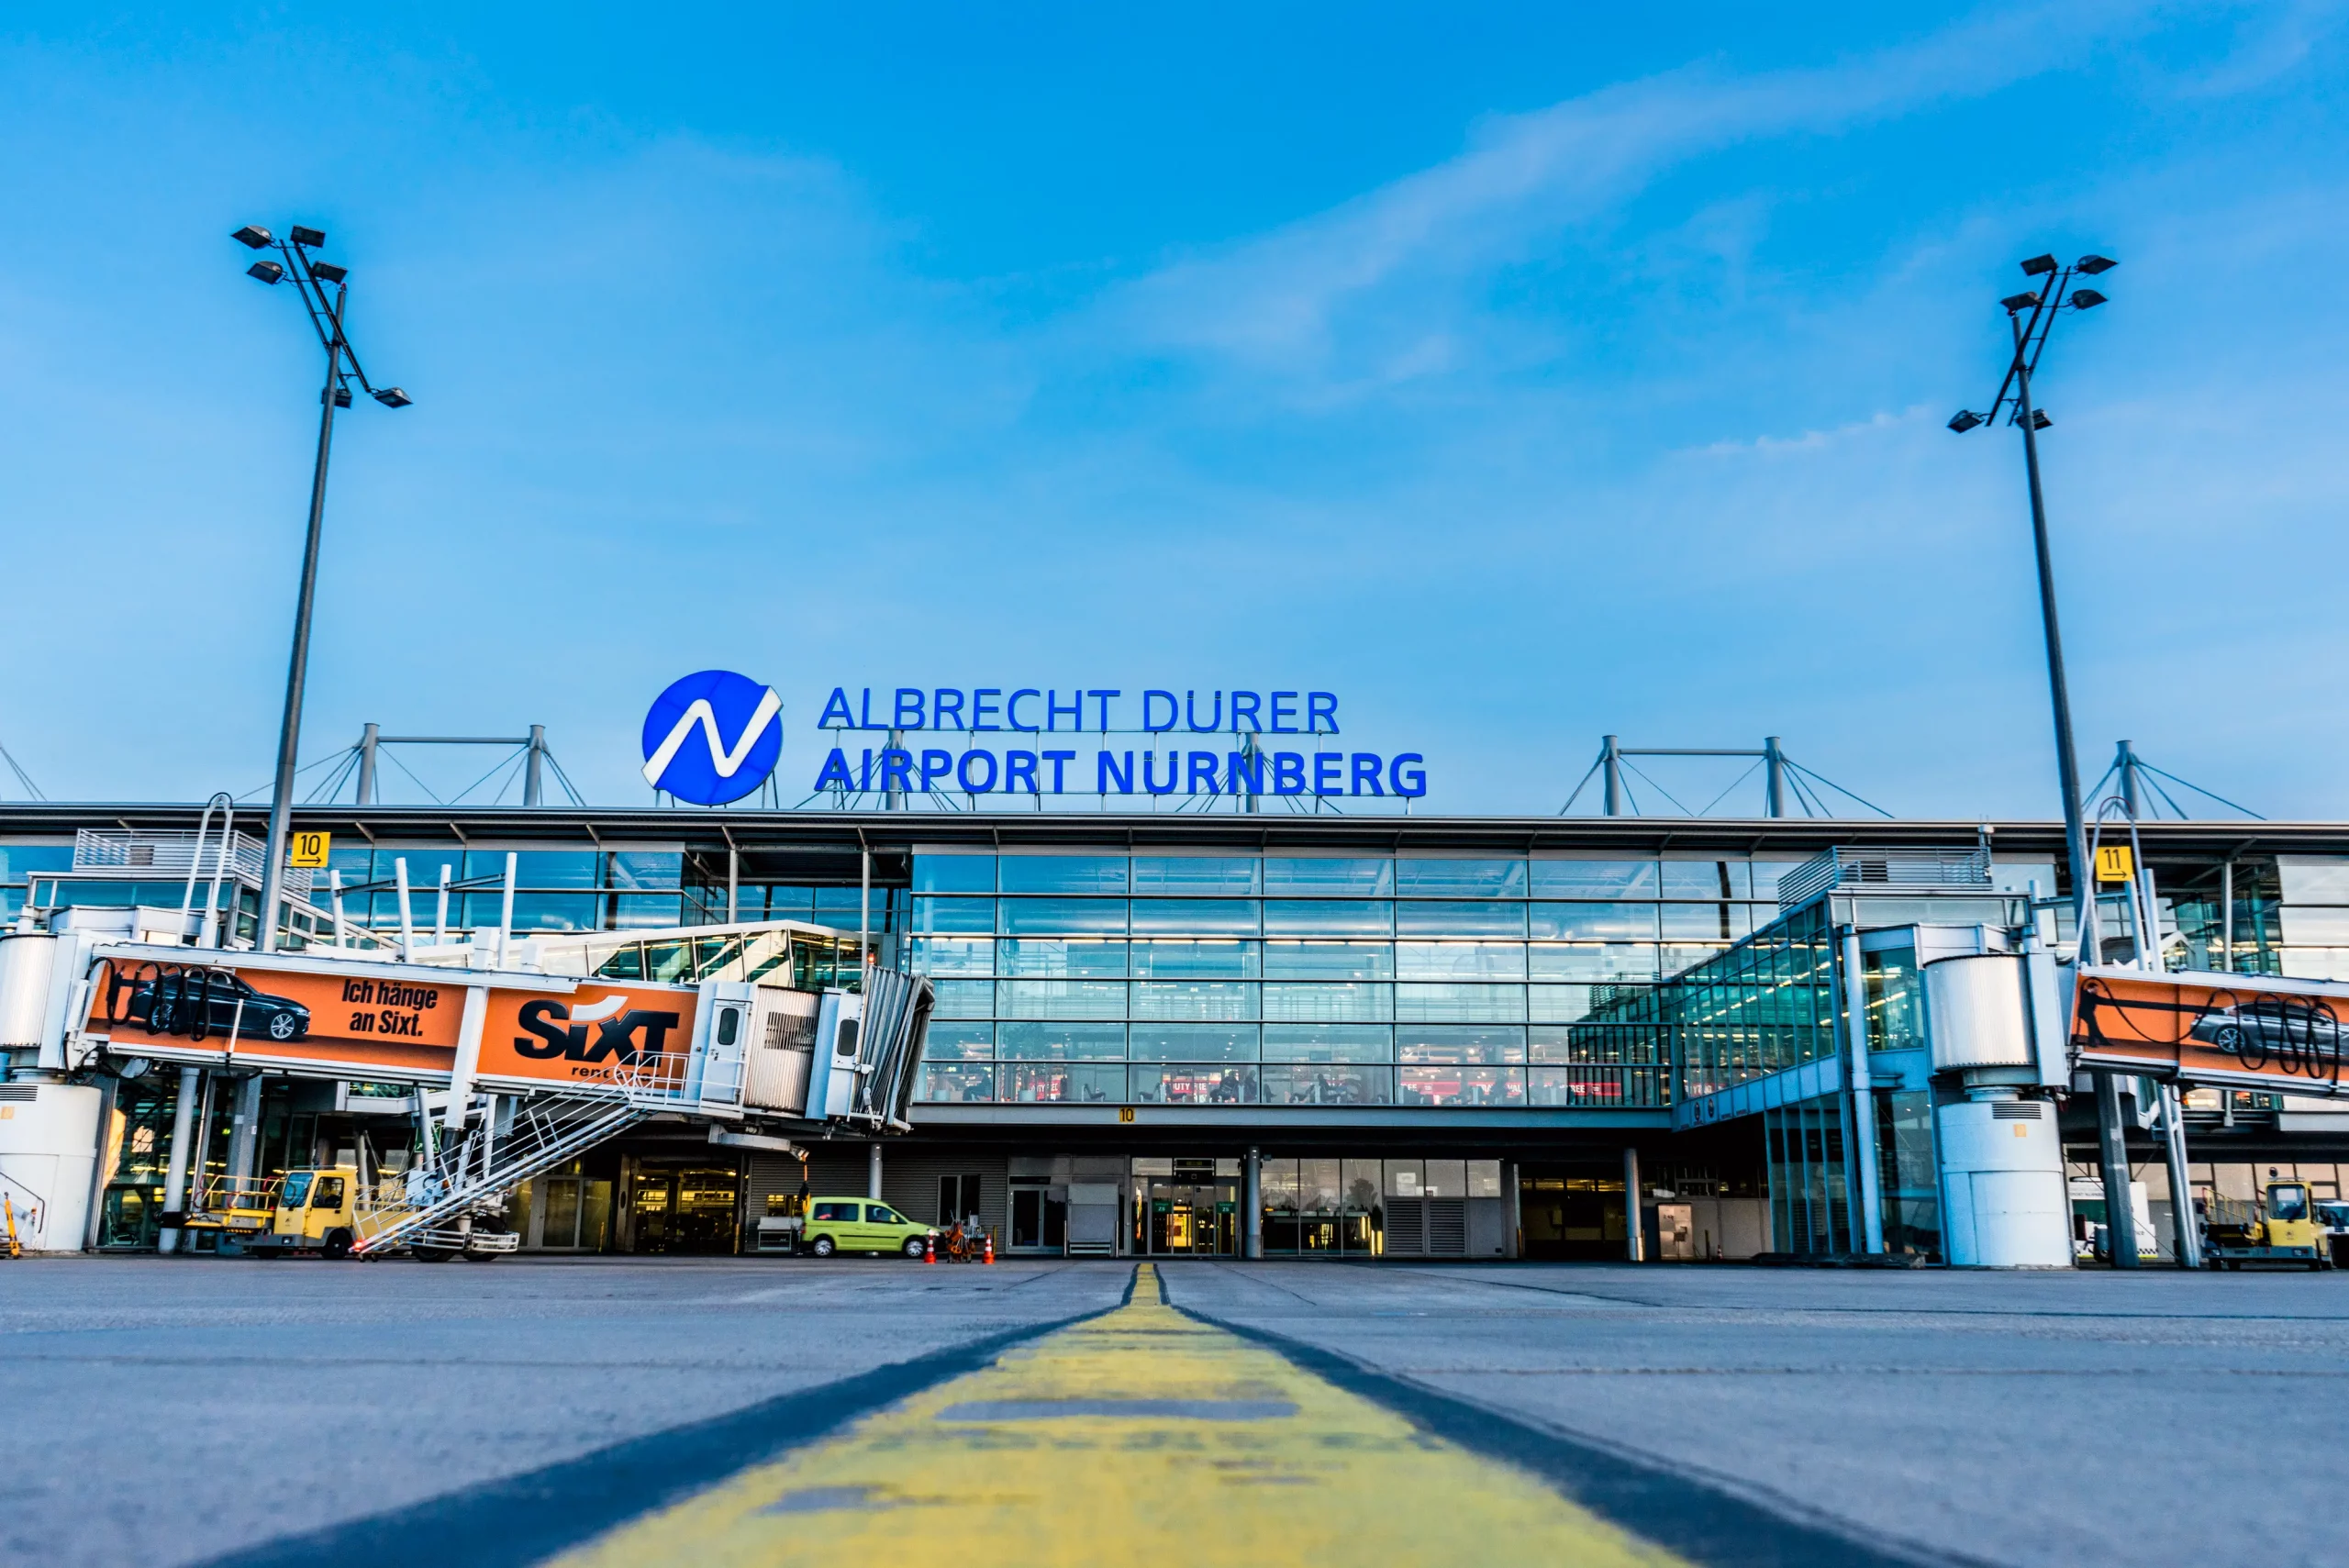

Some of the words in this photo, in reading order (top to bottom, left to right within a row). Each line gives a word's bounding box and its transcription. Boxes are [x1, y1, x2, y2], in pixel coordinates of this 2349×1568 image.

[818, 686, 1120, 732] ALBRECHT
[814, 748, 1076, 795] AIRPORT
[301, 834, 321, 856] 10
[2104, 848, 2121, 870] 11
[341, 978, 374, 1004] Ich
[376, 981, 439, 1011] hänge
[349, 1011, 375, 1032] an
[378, 1009, 424, 1037] Sixt.
[572, 1065, 610, 1079] rent
[1120, 1107, 1134, 1122] 10
